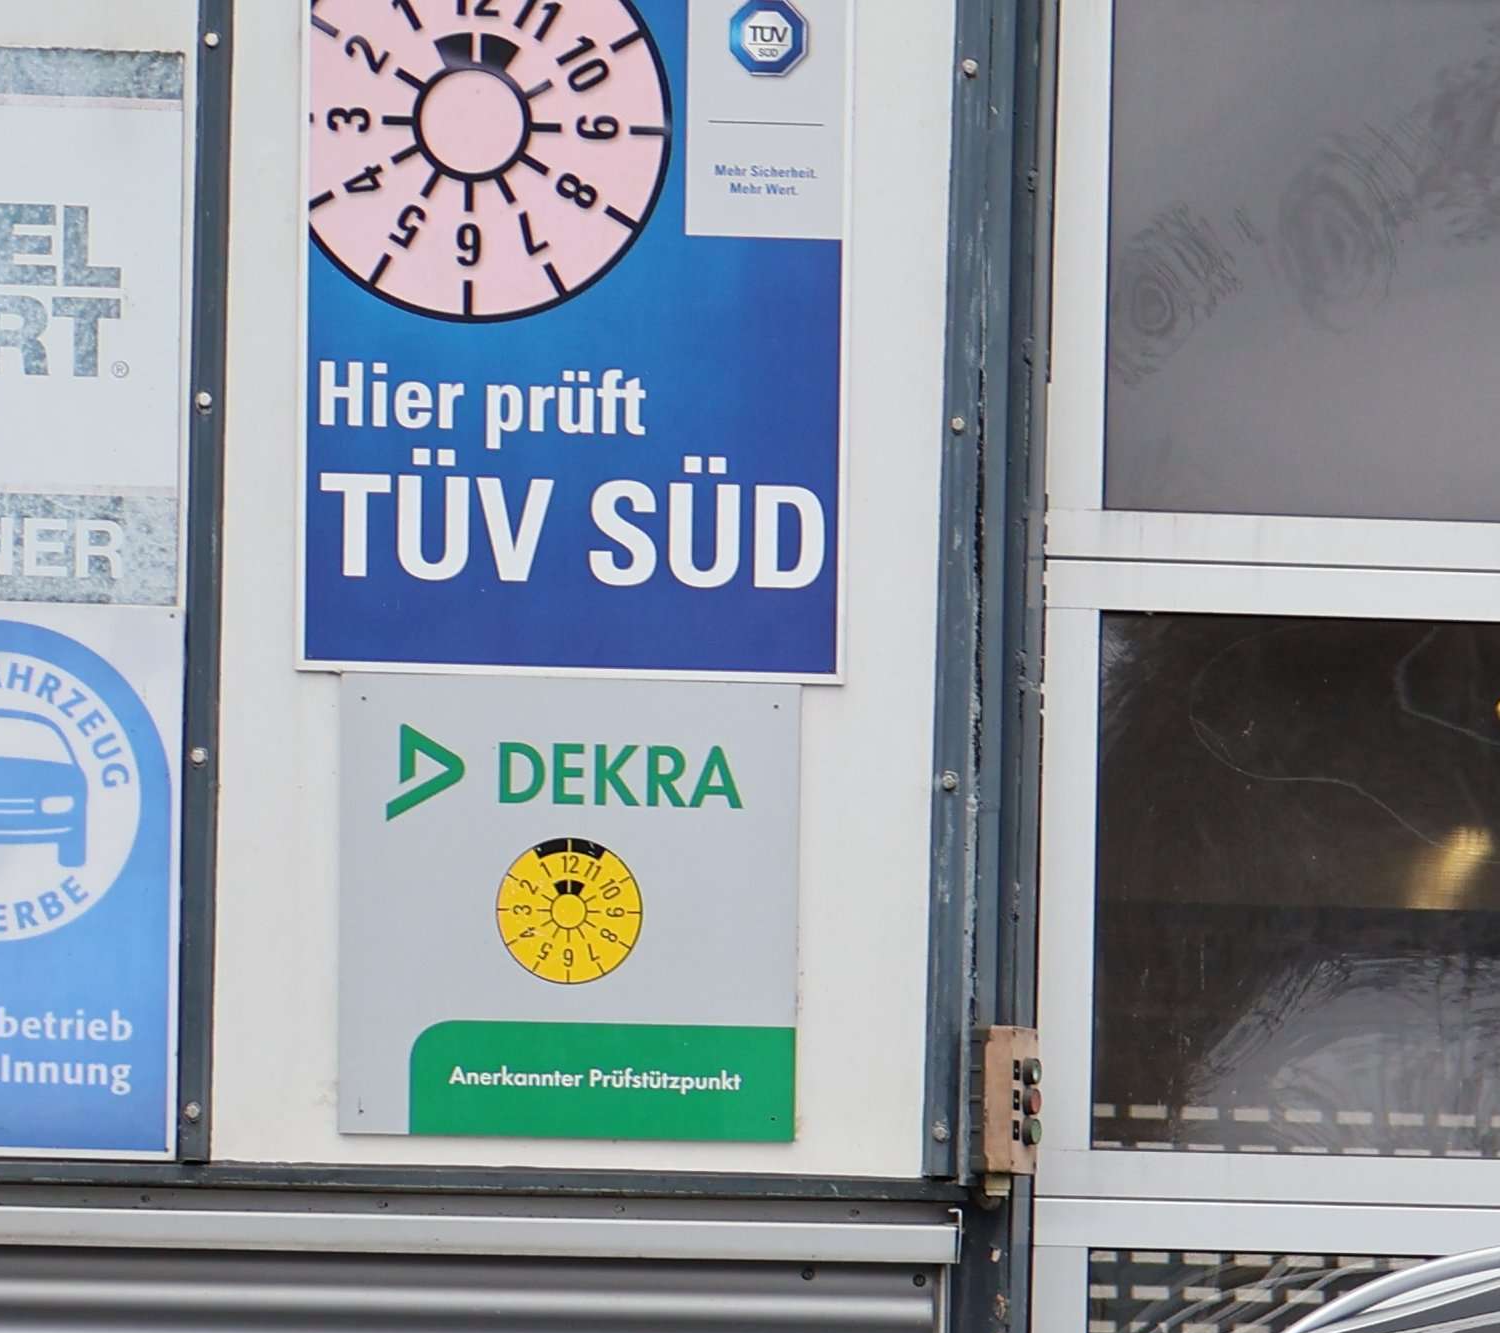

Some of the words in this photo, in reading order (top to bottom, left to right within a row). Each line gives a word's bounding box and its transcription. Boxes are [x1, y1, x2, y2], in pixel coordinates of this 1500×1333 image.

[344, 35, 390, 75] 2
[556, 35, 610, 93] 10
[327, 107, 371, 133] 3
[343, 165, 384, 194] 4
[714, 164, 747, 177] Mehr
[555, 172, 598, 210] 8
[729, 182, 762, 195] Mehr
[765, 183, 799, 196] Wert.
[388, 204, 427, 250] 5
[518, 210, 550, 257] 7
[318, 360, 464, 430] Hier
[484, 369, 646, 451] prüft
[319, 448, 555, 583] TÜV
[588, 456, 826, 590] SÜD
[498, 741, 744, 810] DEKRA
[561, 855, 580, 874] 12
[584, 861, 601, 881] 11
[519, 879, 539, 895] 2
[599, 878, 621, 900] 10
[513, 904, 532, 916] 3
[600, 928, 618, 943] 8
[448, 1065, 584, 1089] Anerkannter
[589, 1067, 742, 1095] Prüfstützpunkt
